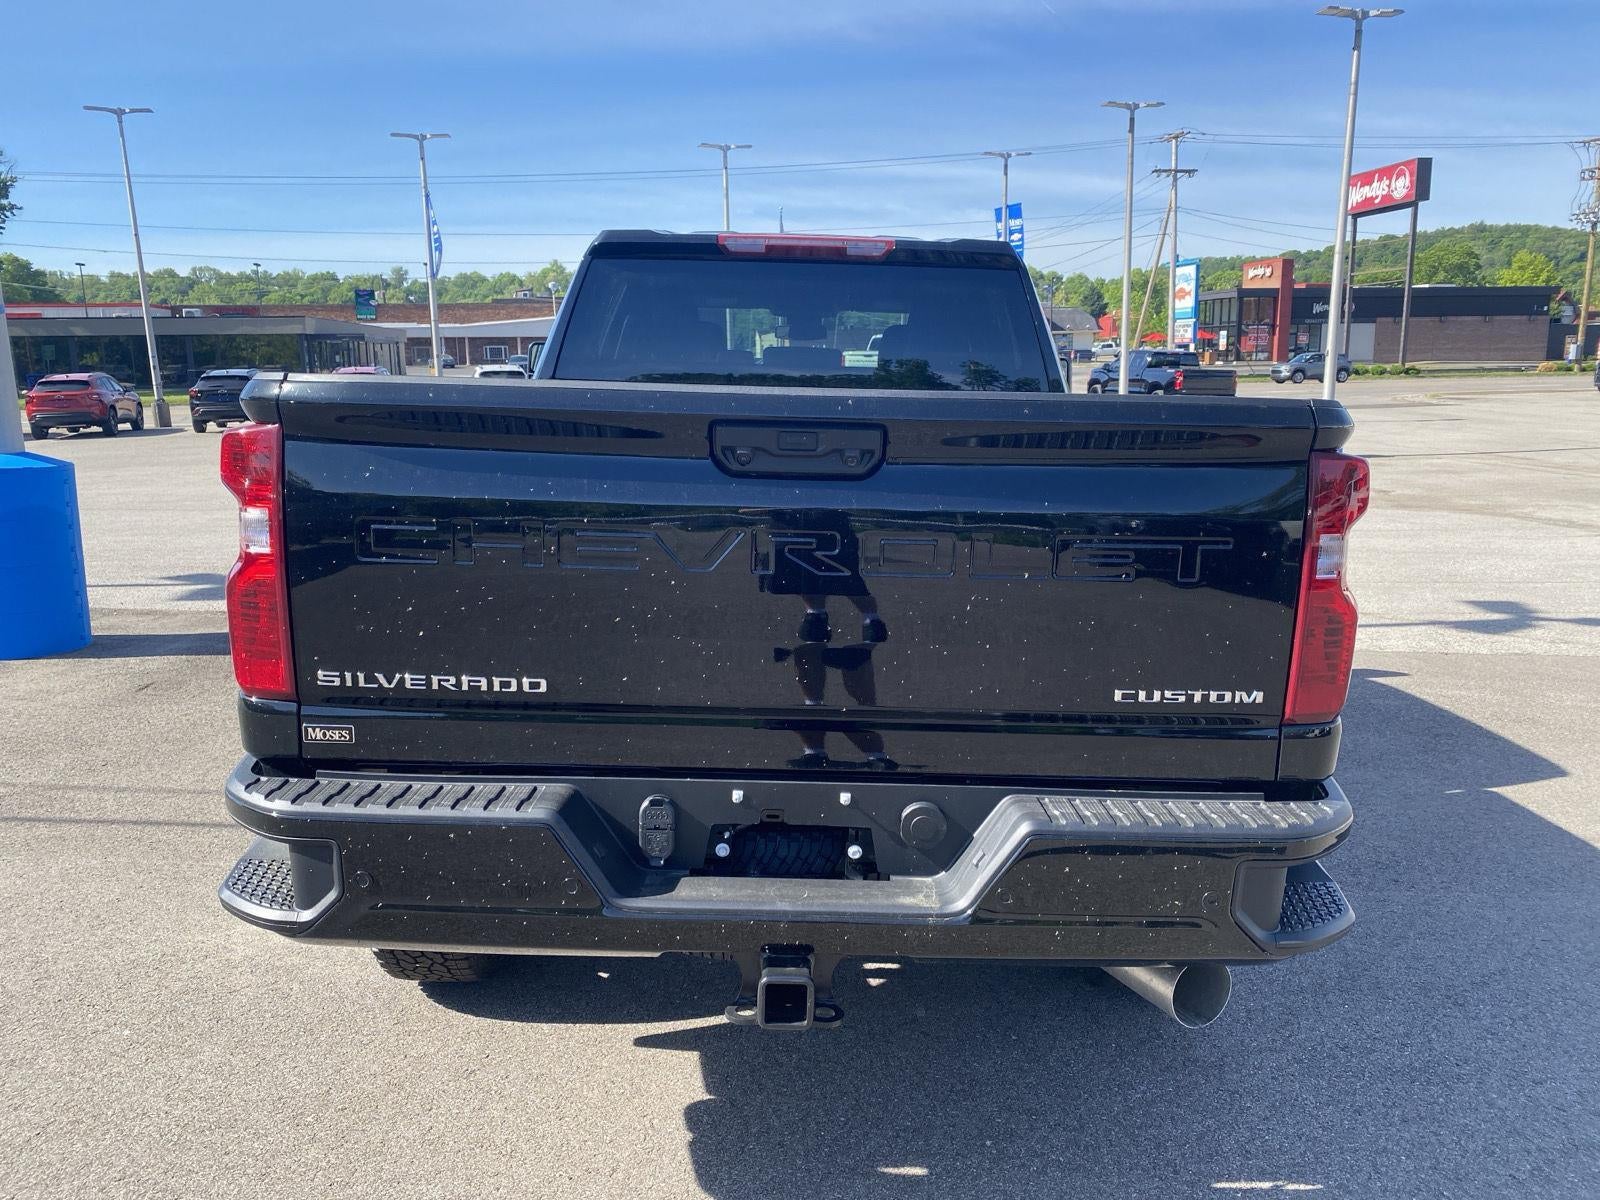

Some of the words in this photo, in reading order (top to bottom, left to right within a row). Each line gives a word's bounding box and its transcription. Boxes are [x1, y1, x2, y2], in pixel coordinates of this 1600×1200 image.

[1347, 173, 1390, 211] Wendy's
[354, 515, 1235, 584] CHEVROLET
[317, 669, 548, 693] SILVERADO
[1113, 689, 1265, 704] CUSTOM
[306, 727, 350, 741] MOSES
